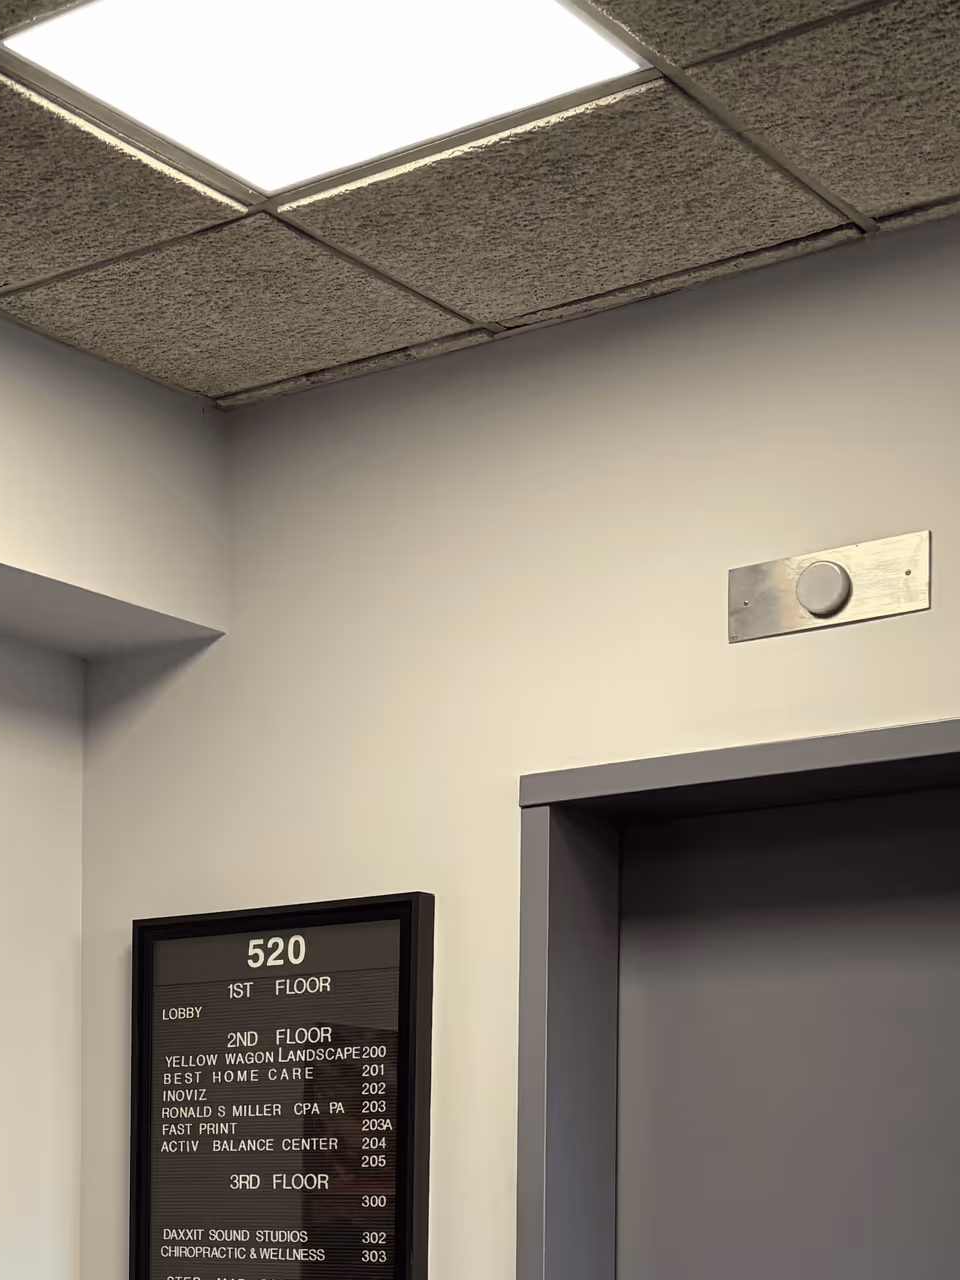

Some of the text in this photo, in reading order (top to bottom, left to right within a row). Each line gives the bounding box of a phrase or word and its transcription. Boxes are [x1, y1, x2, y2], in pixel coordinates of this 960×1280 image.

[247, 935, 306, 968] 520
[228, 976, 331, 998] 1ST FLOOR
[162, 1007, 202, 1020] LOBBY
[227, 1027, 332, 1048] 2ND FLOOR
[166, 1046, 386, 1067] YELLOW WAGON LANDSCAPE 200
[163, 1064, 385, 1084] BEST HOME CARE 201
[163, 1083, 385, 1101] INOVIZ 202
[161, 1101, 386, 1118] RONALD S MILLER CPA PA 203
[163, 1119, 392, 1135] FAST PRINT 203A
[161, 1137, 386, 1152] ACTIV BALANCE CENTER 204
[361, 1155, 386, 1167] 205
[230, 1174, 328, 1190] 3RD FLOOR
[362, 1196, 386, 1207] 300
[163, 1229, 386, 1244] DAXXIT SOUND STUDIOS 302
[161, 1246, 387, 1262] CHIROPRACTIC & WELLNESS 303
